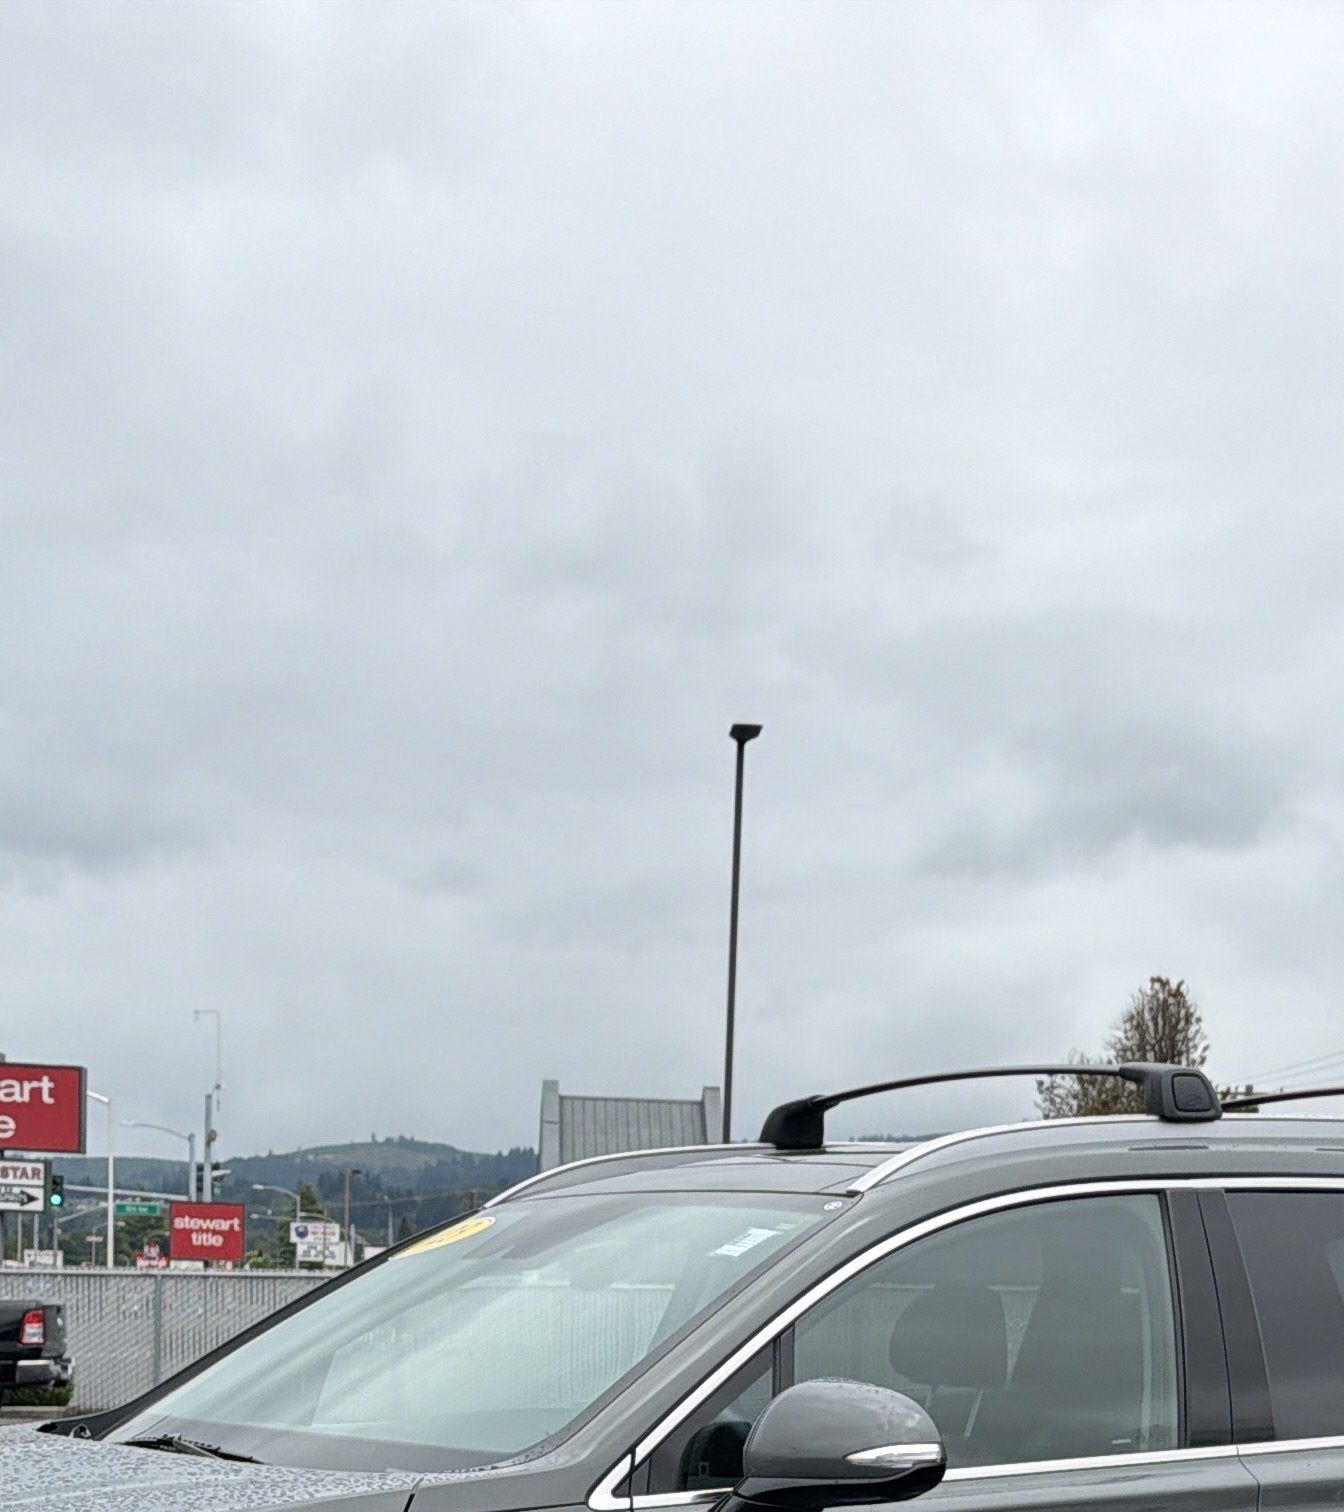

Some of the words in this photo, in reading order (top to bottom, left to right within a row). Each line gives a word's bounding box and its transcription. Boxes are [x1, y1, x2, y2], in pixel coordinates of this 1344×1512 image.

[0, 1166, 42, 1181] STAR
[173, 1215, 241, 1232] stewart
[191, 1231, 224, 1247] title
